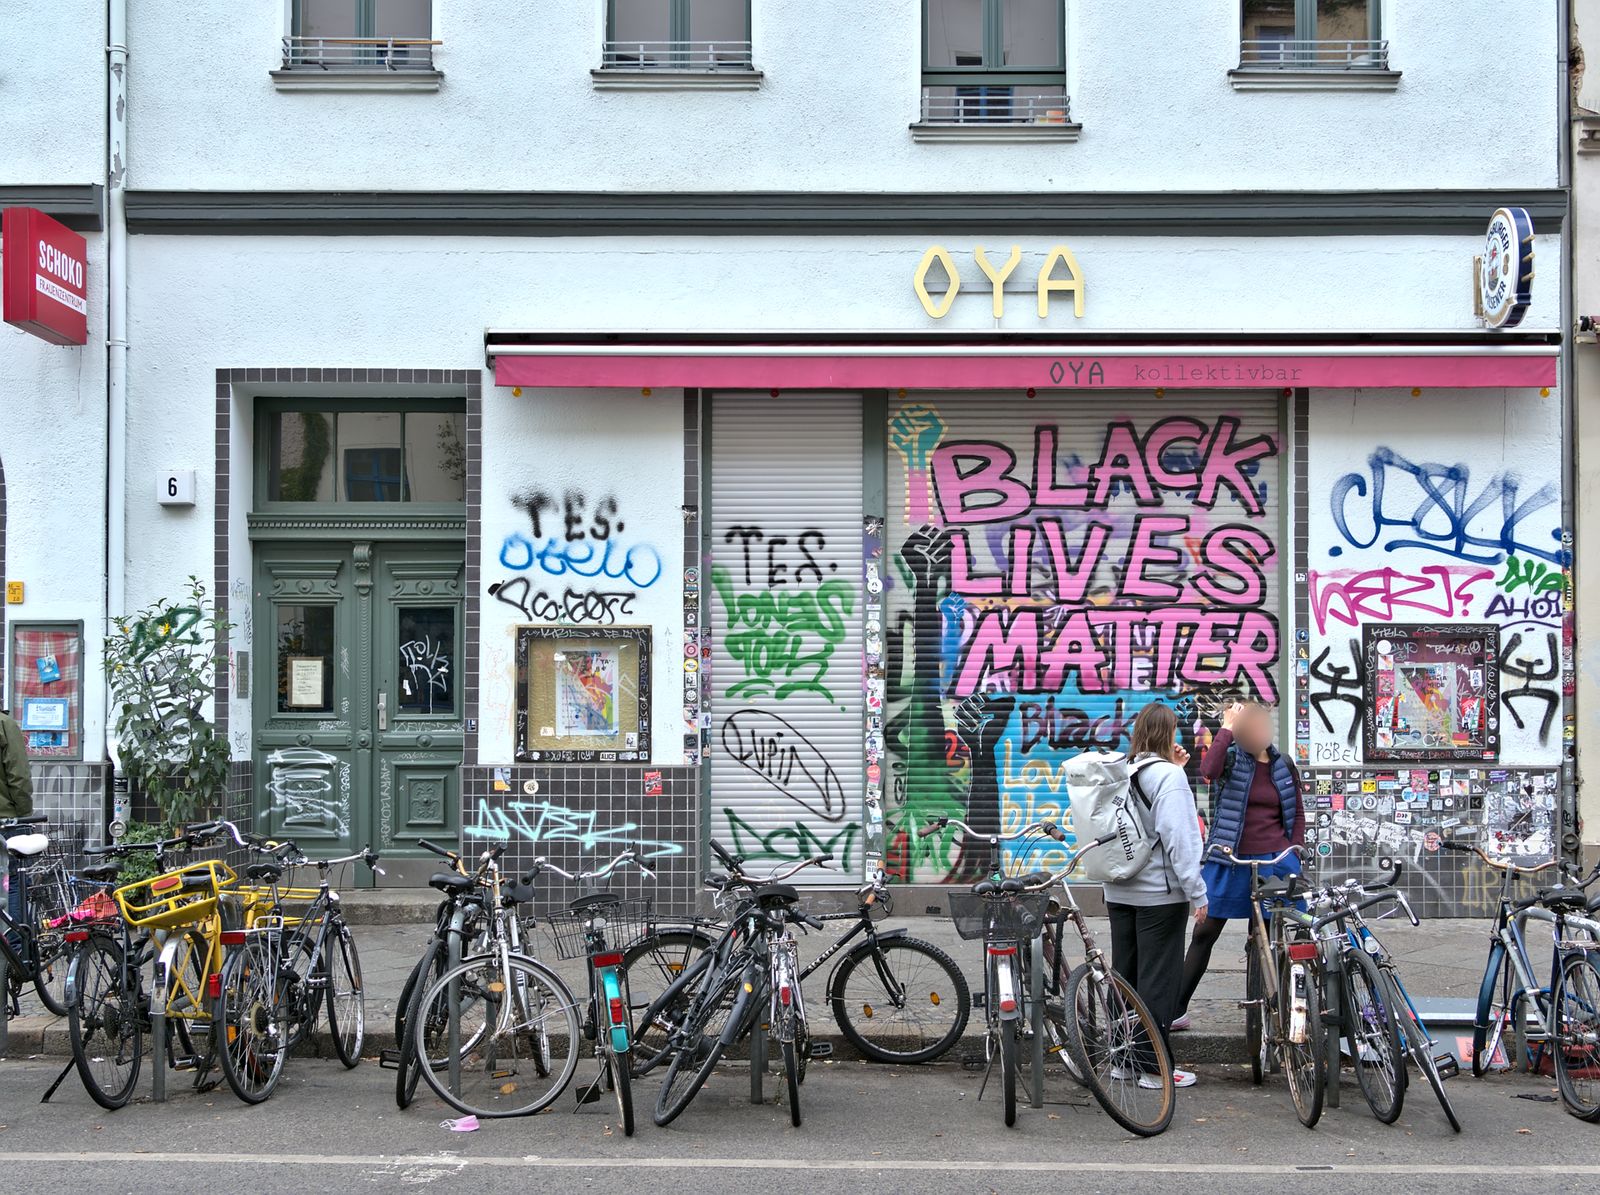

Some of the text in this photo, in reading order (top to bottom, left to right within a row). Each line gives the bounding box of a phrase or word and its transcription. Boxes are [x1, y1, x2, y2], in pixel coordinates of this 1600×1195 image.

[39, 240, 83, 289] SCHOKO
[913, 245, 1084, 319] OYA
[39, 278, 83, 310] FRAUENZENTRUM
[1049, 361, 1303, 385] OYA kollektivbar
[167, 477, 178, 497] 6
[930, 414, 1278, 526] BLACK
[947, 512, 1277, 609] LIVES
[946, 604, 1281, 707] MATTER
[1115, 807, 1136, 862] Columbia
